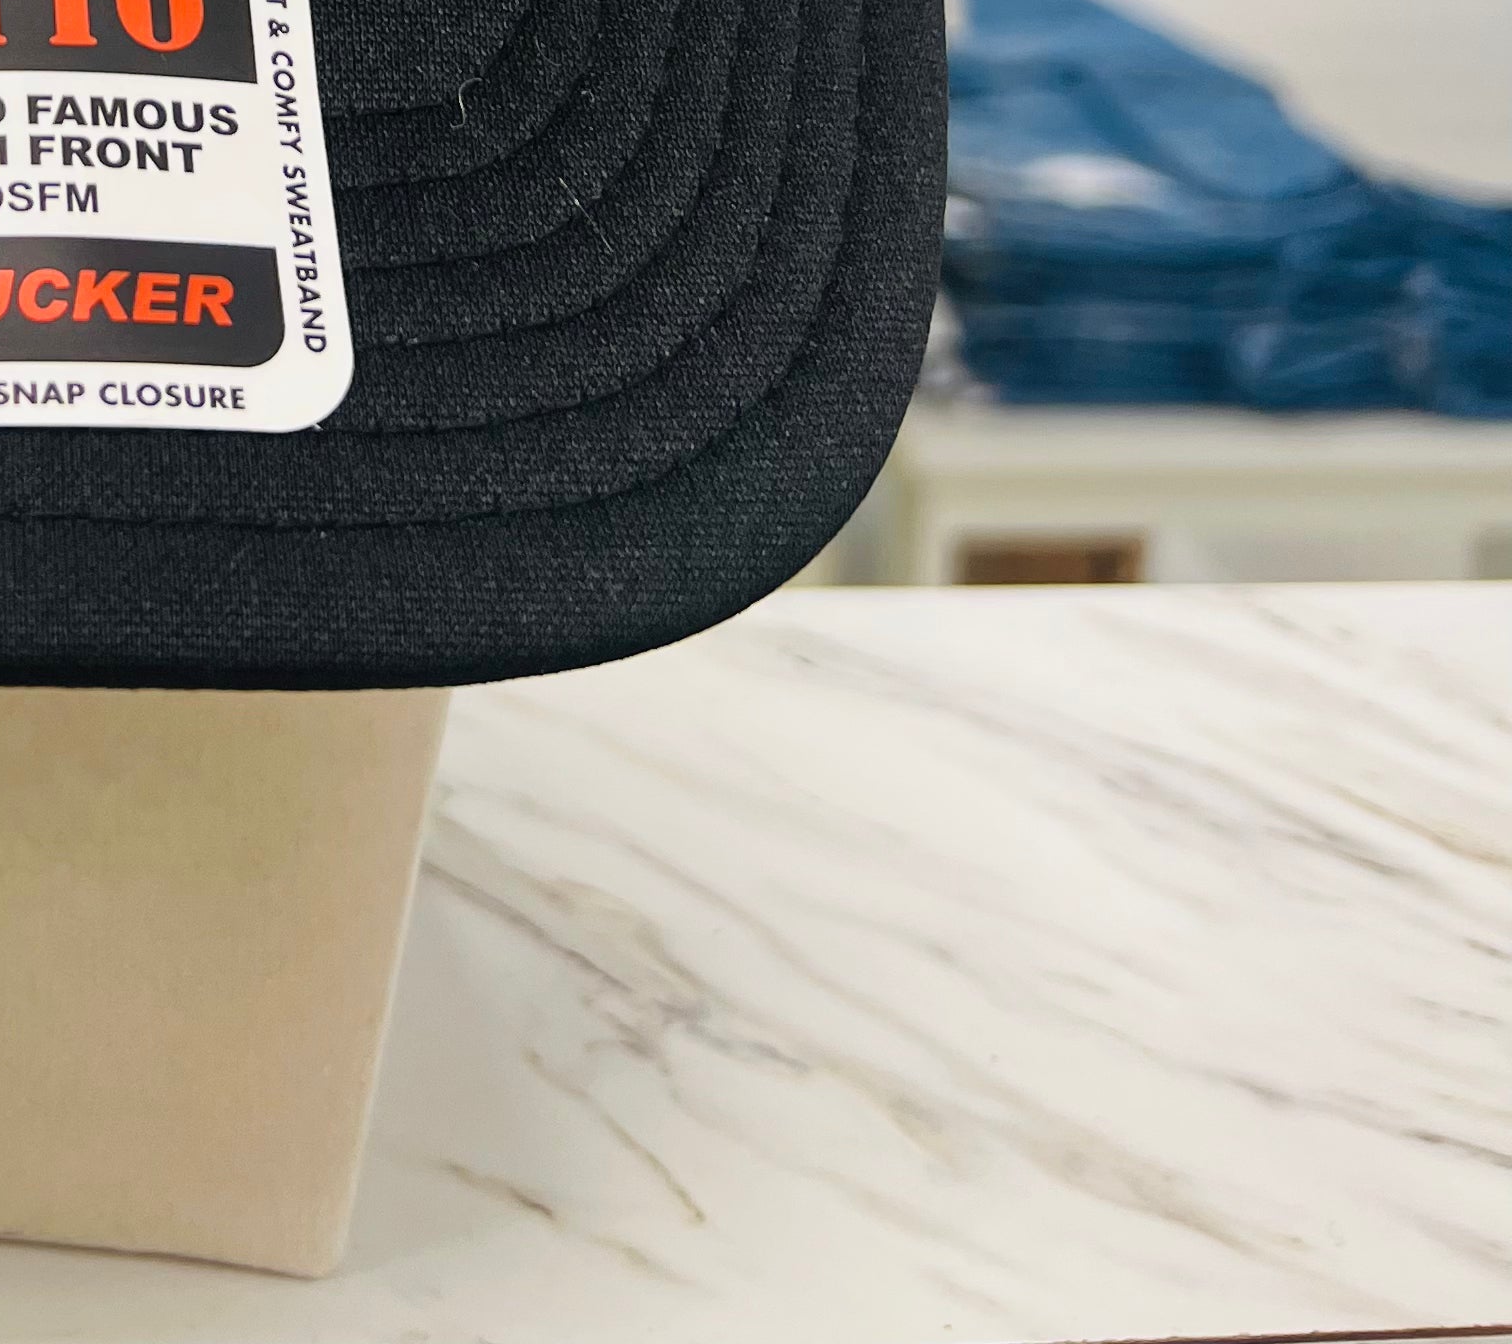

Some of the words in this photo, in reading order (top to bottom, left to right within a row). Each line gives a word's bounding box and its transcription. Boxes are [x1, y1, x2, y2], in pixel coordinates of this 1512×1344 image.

[269, 18, 290, 37] &
[27, 95, 239, 136] FAMOUS
[271, 51, 304, 154] COMFY
[30, 136, 203, 173] FRONT
[282, 164, 327, 353] SWEATBAND
[99, 382, 246, 410] CLOSURE
